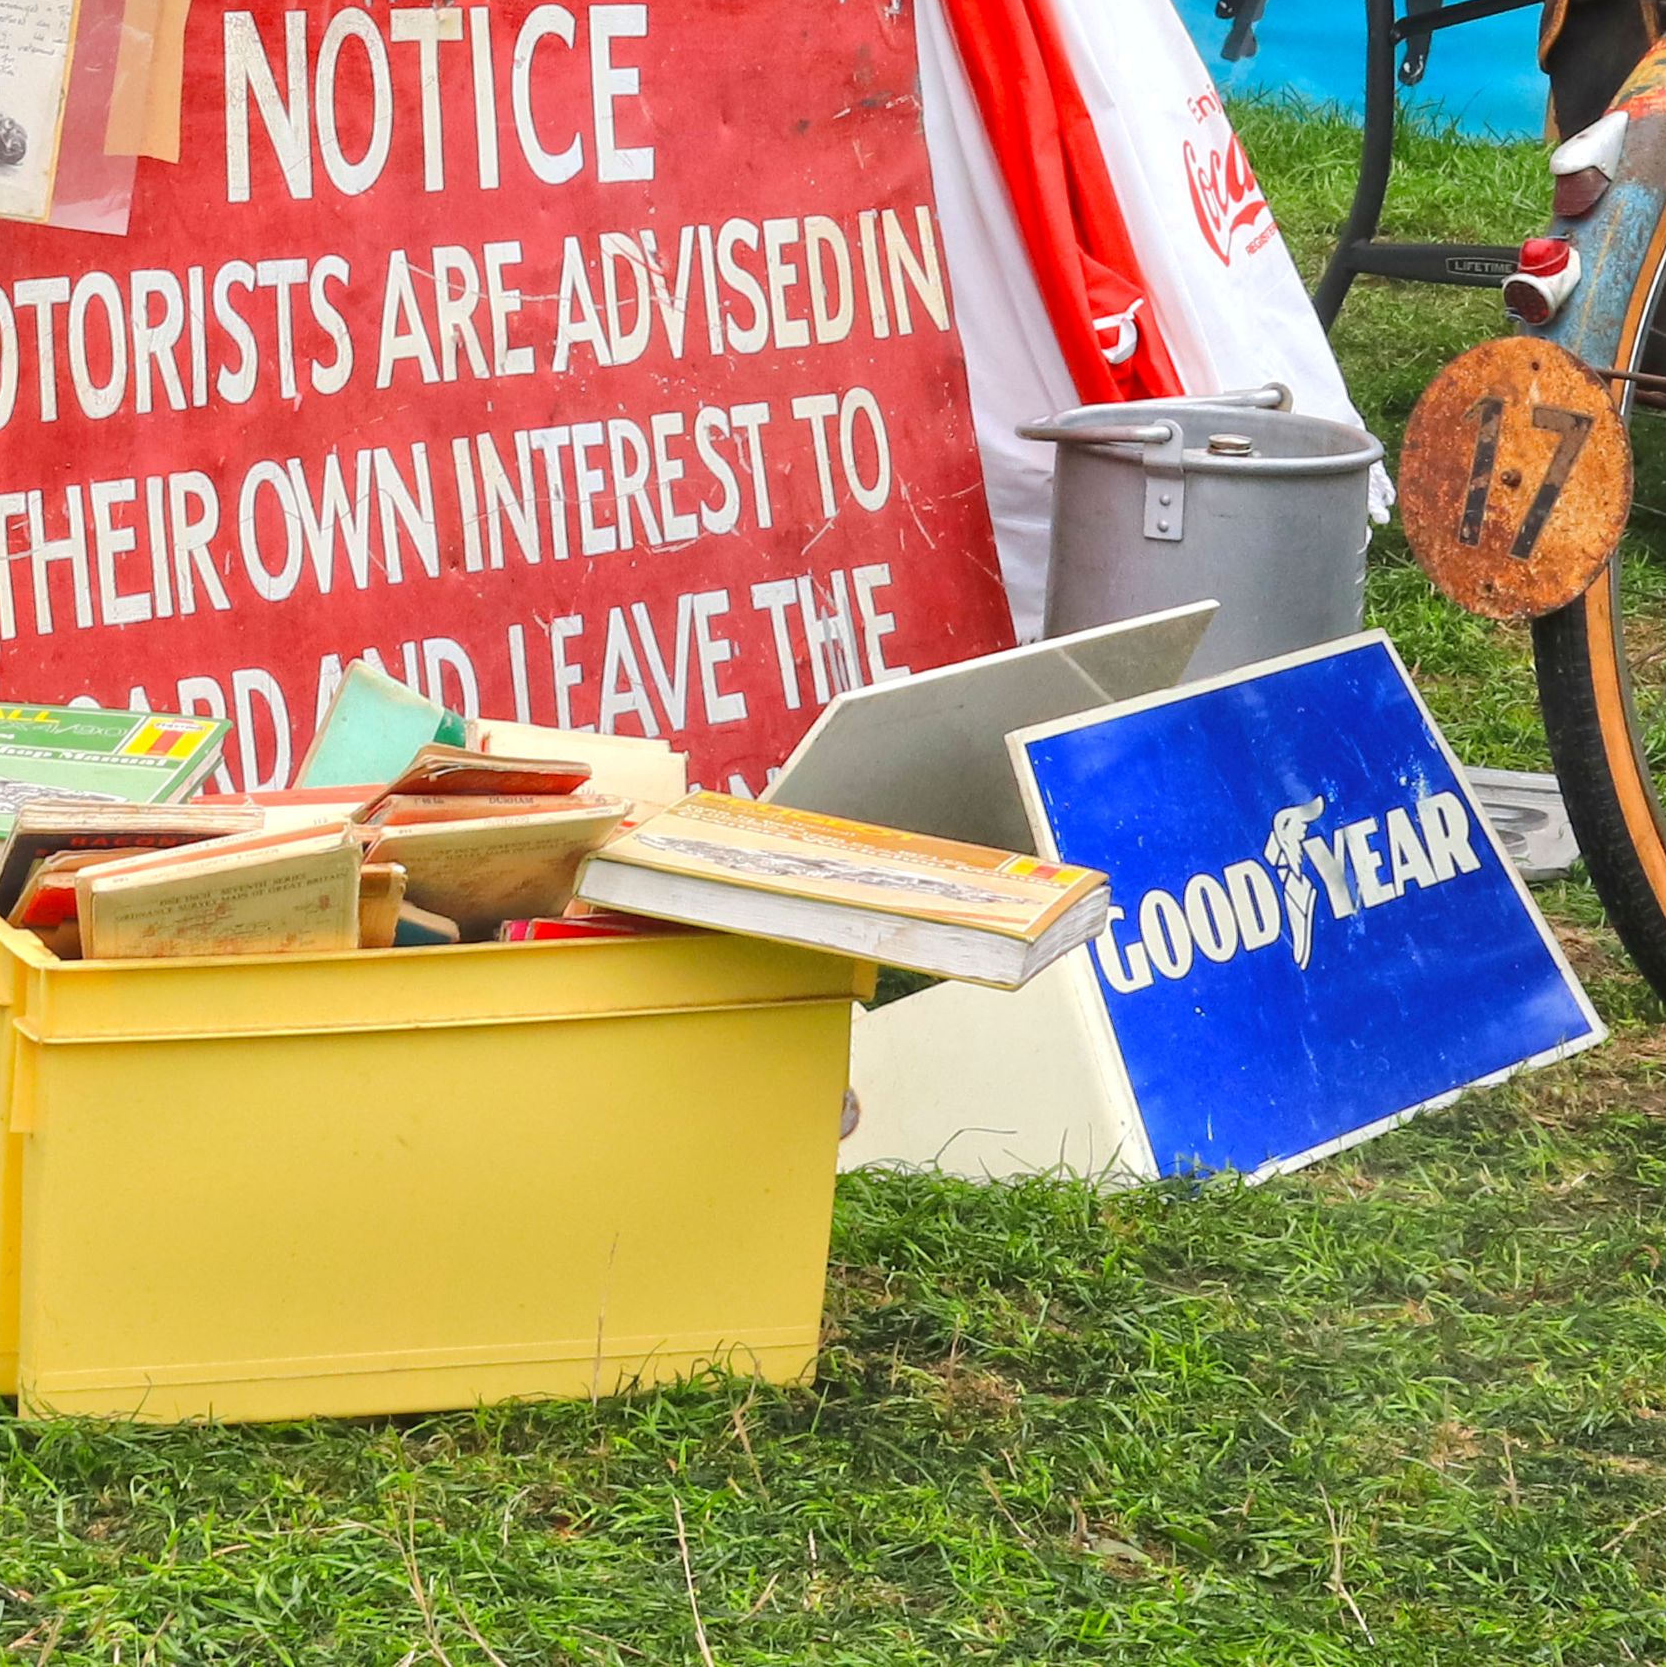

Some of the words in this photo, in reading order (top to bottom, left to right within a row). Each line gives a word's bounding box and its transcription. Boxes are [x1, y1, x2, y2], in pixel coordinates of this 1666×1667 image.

[222, 1, 656, 203] NOTICE
[375, 239, 536, 391] ARE
[552, 214, 855, 374] ADVISED
[858, 205, 951, 340] IN
[1454, 259, 1515, 275] LIFETIME
[237, 441, 441, 604] OWN
[449, 401, 772, 573] INTEREST
[791, 386, 892, 522] TO
[1461, 394, 1595, 561] 17
[750, 563, 913, 711] THE
[59, 750, 170, 768] Manual
